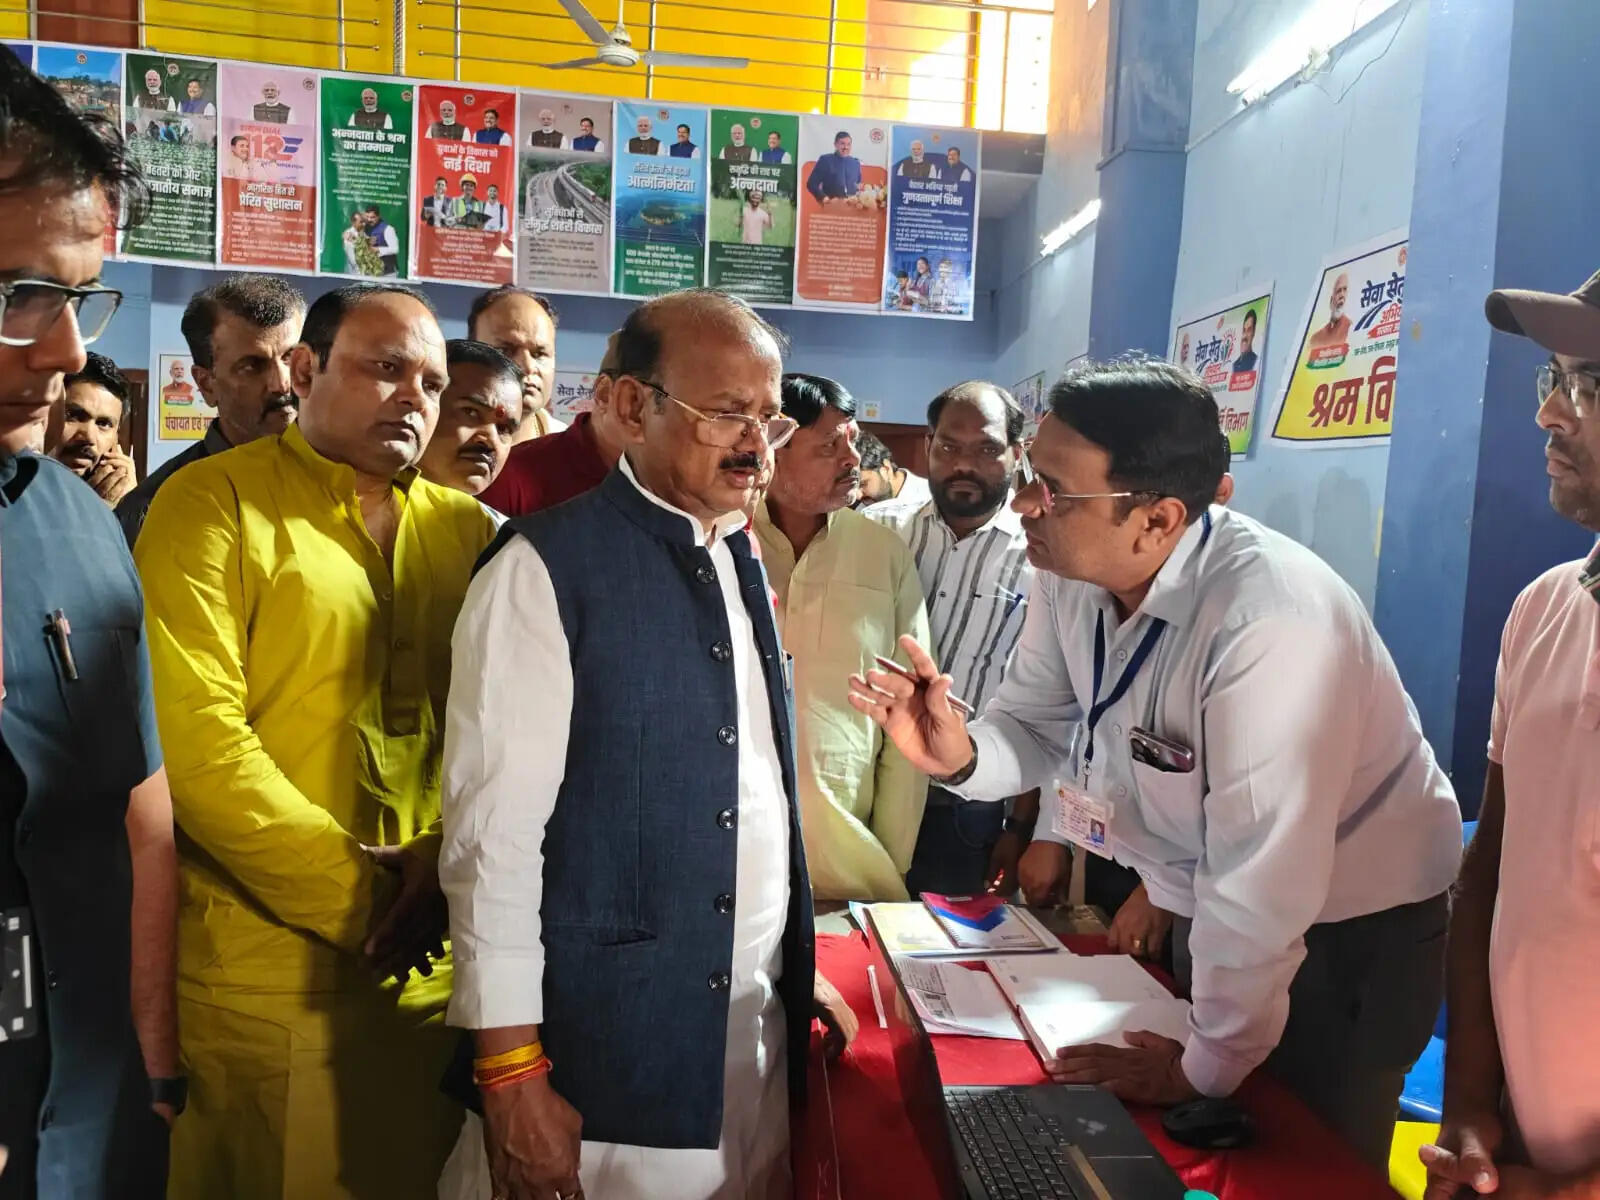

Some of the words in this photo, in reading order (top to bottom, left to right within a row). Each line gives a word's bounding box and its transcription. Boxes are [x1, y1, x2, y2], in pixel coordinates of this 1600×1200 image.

[331, 128, 374, 141] अन्नदाता
[375, 129, 386, 141] के
[343, 139, 356, 151] का
[357, 141, 395, 154] सम्मान
[443, 154, 463, 172] नई
[464, 155, 492, 174] दिशा
[144, 180, 181, 195] जातीय
[181, 184, 213, 198] समाज
[627, 175, 696, 193] आत्मनिर्भरता
[729, 177, 779, 193] अन्नदाता
[263, 196, 304, 212] सुशासन
[1361, 279, 1386, 308] सेवा
[1195, 340, 1209, 363] सेवा
[1208, 335, 1222, 362] सेतु
[556, 384, 575, 397] सेवा
[1307, 377, 1365, 428] श्रम
[1364, 355, 1398, 425] वि
[165, 411, 190, 431] पंचायत
[191, 412, 204, 431] एवं
[1225, 407, 1250, 433] विभाग
